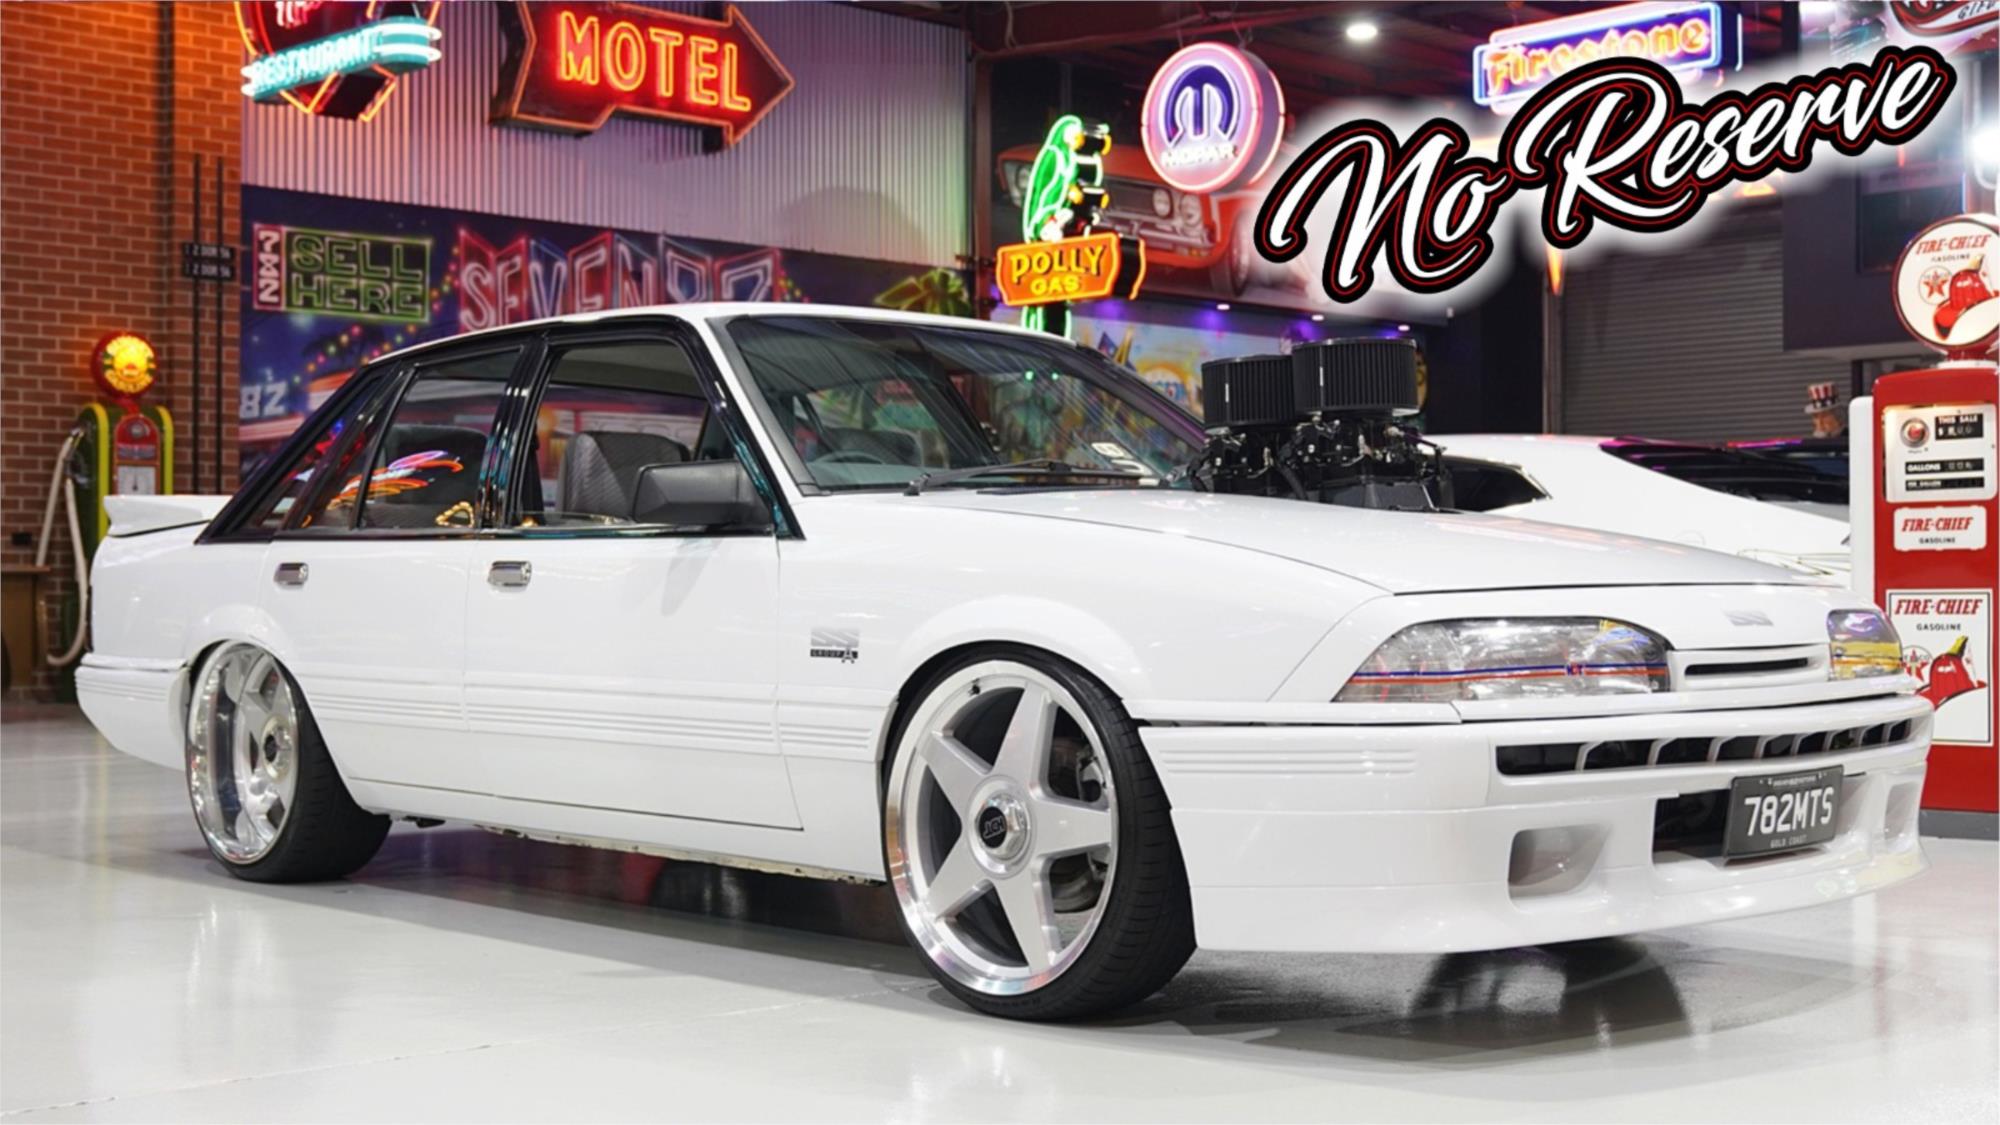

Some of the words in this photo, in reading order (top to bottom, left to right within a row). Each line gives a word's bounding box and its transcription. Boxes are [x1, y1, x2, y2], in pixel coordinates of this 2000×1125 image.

[251, 27, 378, 97] RESTAURANT
[557, 11, 752, 113] MOTEL
[1486, 18, 1710, 97] Firestone
[1160, 142, 1238, 168] MOPAR
[291, 234, 424, 283] SELL
[1915, 234, 1992, 255] FIRE-CHIEF
[1009, 245, 1105, 284] POLLY
[291, 272, 424, 317] HERE
[1030, 275, 1080, 296] GAS
[1901, 516, 1974, 532] FIRE-CHIEF
[1919, 537, 1956, 545] GASOLINE
[1894, 598, 1984, 615] FIRE-CHIEF
[1916, 623, 1962, 631] GASOLINE
[1744, 786, 1834, 836] 782MTS
